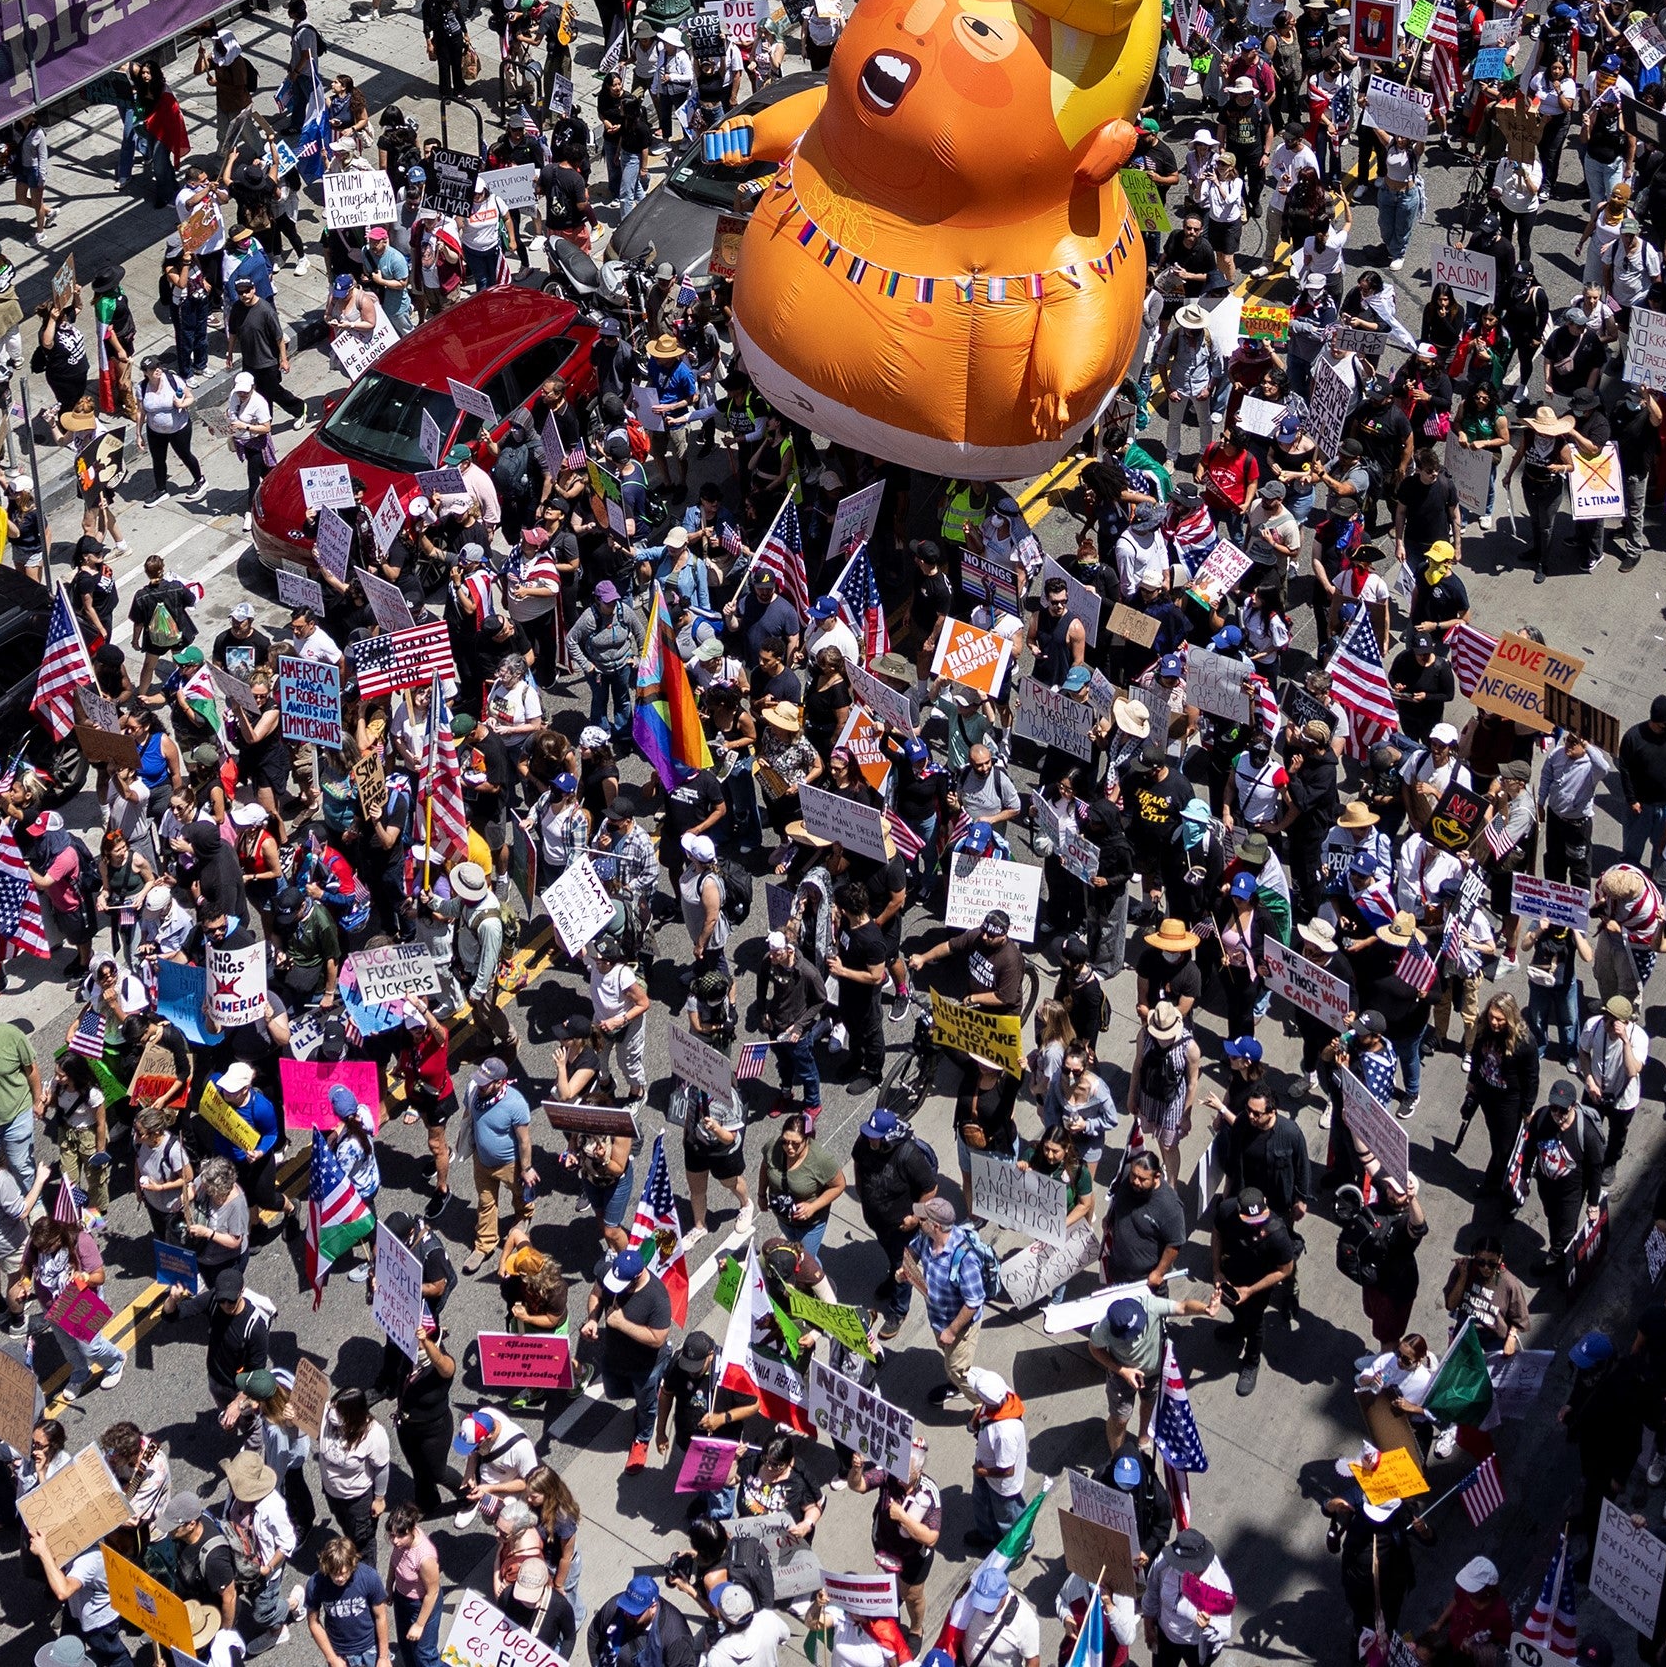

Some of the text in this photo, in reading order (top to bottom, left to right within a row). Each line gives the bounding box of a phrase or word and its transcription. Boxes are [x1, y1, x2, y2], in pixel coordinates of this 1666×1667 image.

[724, 1, 756, 18] DUE
[1370, 77, 1433, 106] ICE MELTS
[434, 150, 479, 165] YOU ARE
[424, 194, 471, 218] KILMAR
[1443, 247, 1474, 264] FUCK
[1435, 262, 1490, 292] RACISM
[1590, 493, 1620, 506] TIRANO
[979, 558, 1013, 583] KINGS
[945, 634, 996, 668] HOME
[955, 630, 975, 648] NO
[279, 659, 336, 686] AMERICA
[951, 648, 1001, 681] DESPOTS
[1497, 641, 1576, 686] LOVE THY
[285, 687, 338, 709] PROBLEM
[1477, 678, 1547, 714] NEIGHBO
[282, 713, 341, 745] IMMIGRANTS
[355, 752, 379, 782] STOP
[1448, 793, 1480, 824] NO
[350, 943, 429, 969] FUCK THESE
[366, 960, 424, 981] FUCKING
[1281, 949, 1337, 989] WE SPEAK
[364, 977, 434, 999] FUCKERS
[1265, 953, 1348, 1014] FOR THOSE WHO
[214, 993, 266, 1013] AMERICA
[937, 1000, 998, 1030] HUMAN
[936, 1032, 1017, 1073] POLITICAL
[817, 1368, 913, 1437] NO MORE
[827, 1391, 901, 1460] TRUMP
